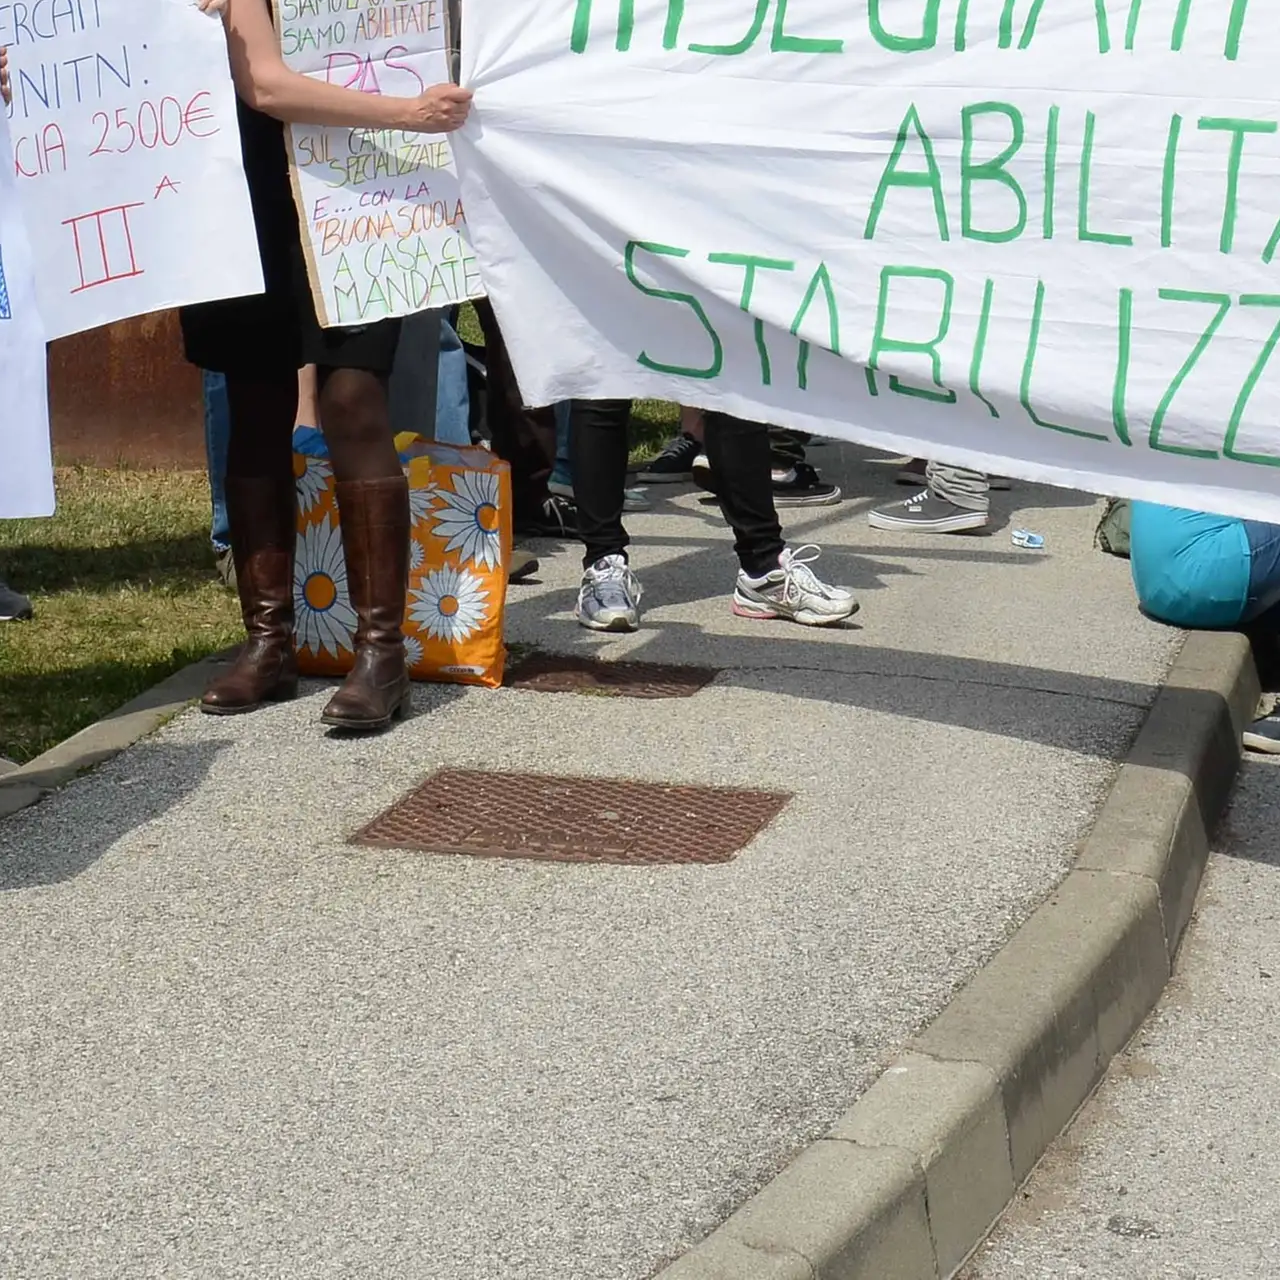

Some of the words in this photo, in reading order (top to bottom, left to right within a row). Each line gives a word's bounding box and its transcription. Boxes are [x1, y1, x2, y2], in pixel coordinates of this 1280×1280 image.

[282, 21, 346, 56] SIAMO
[353, 0, 441, 44] ABILITATE
[88, 90, 220, 158] 2500€
[324, 139, 454, 189] SPECIALIZZATE
[358, 188, 396, 208] CON
[404, 181, 431, 200] LA
[333, 252, 354, 282] A
[363, 236, 433, 278] CASA
[333, 257, 480, 324] MANDATE
